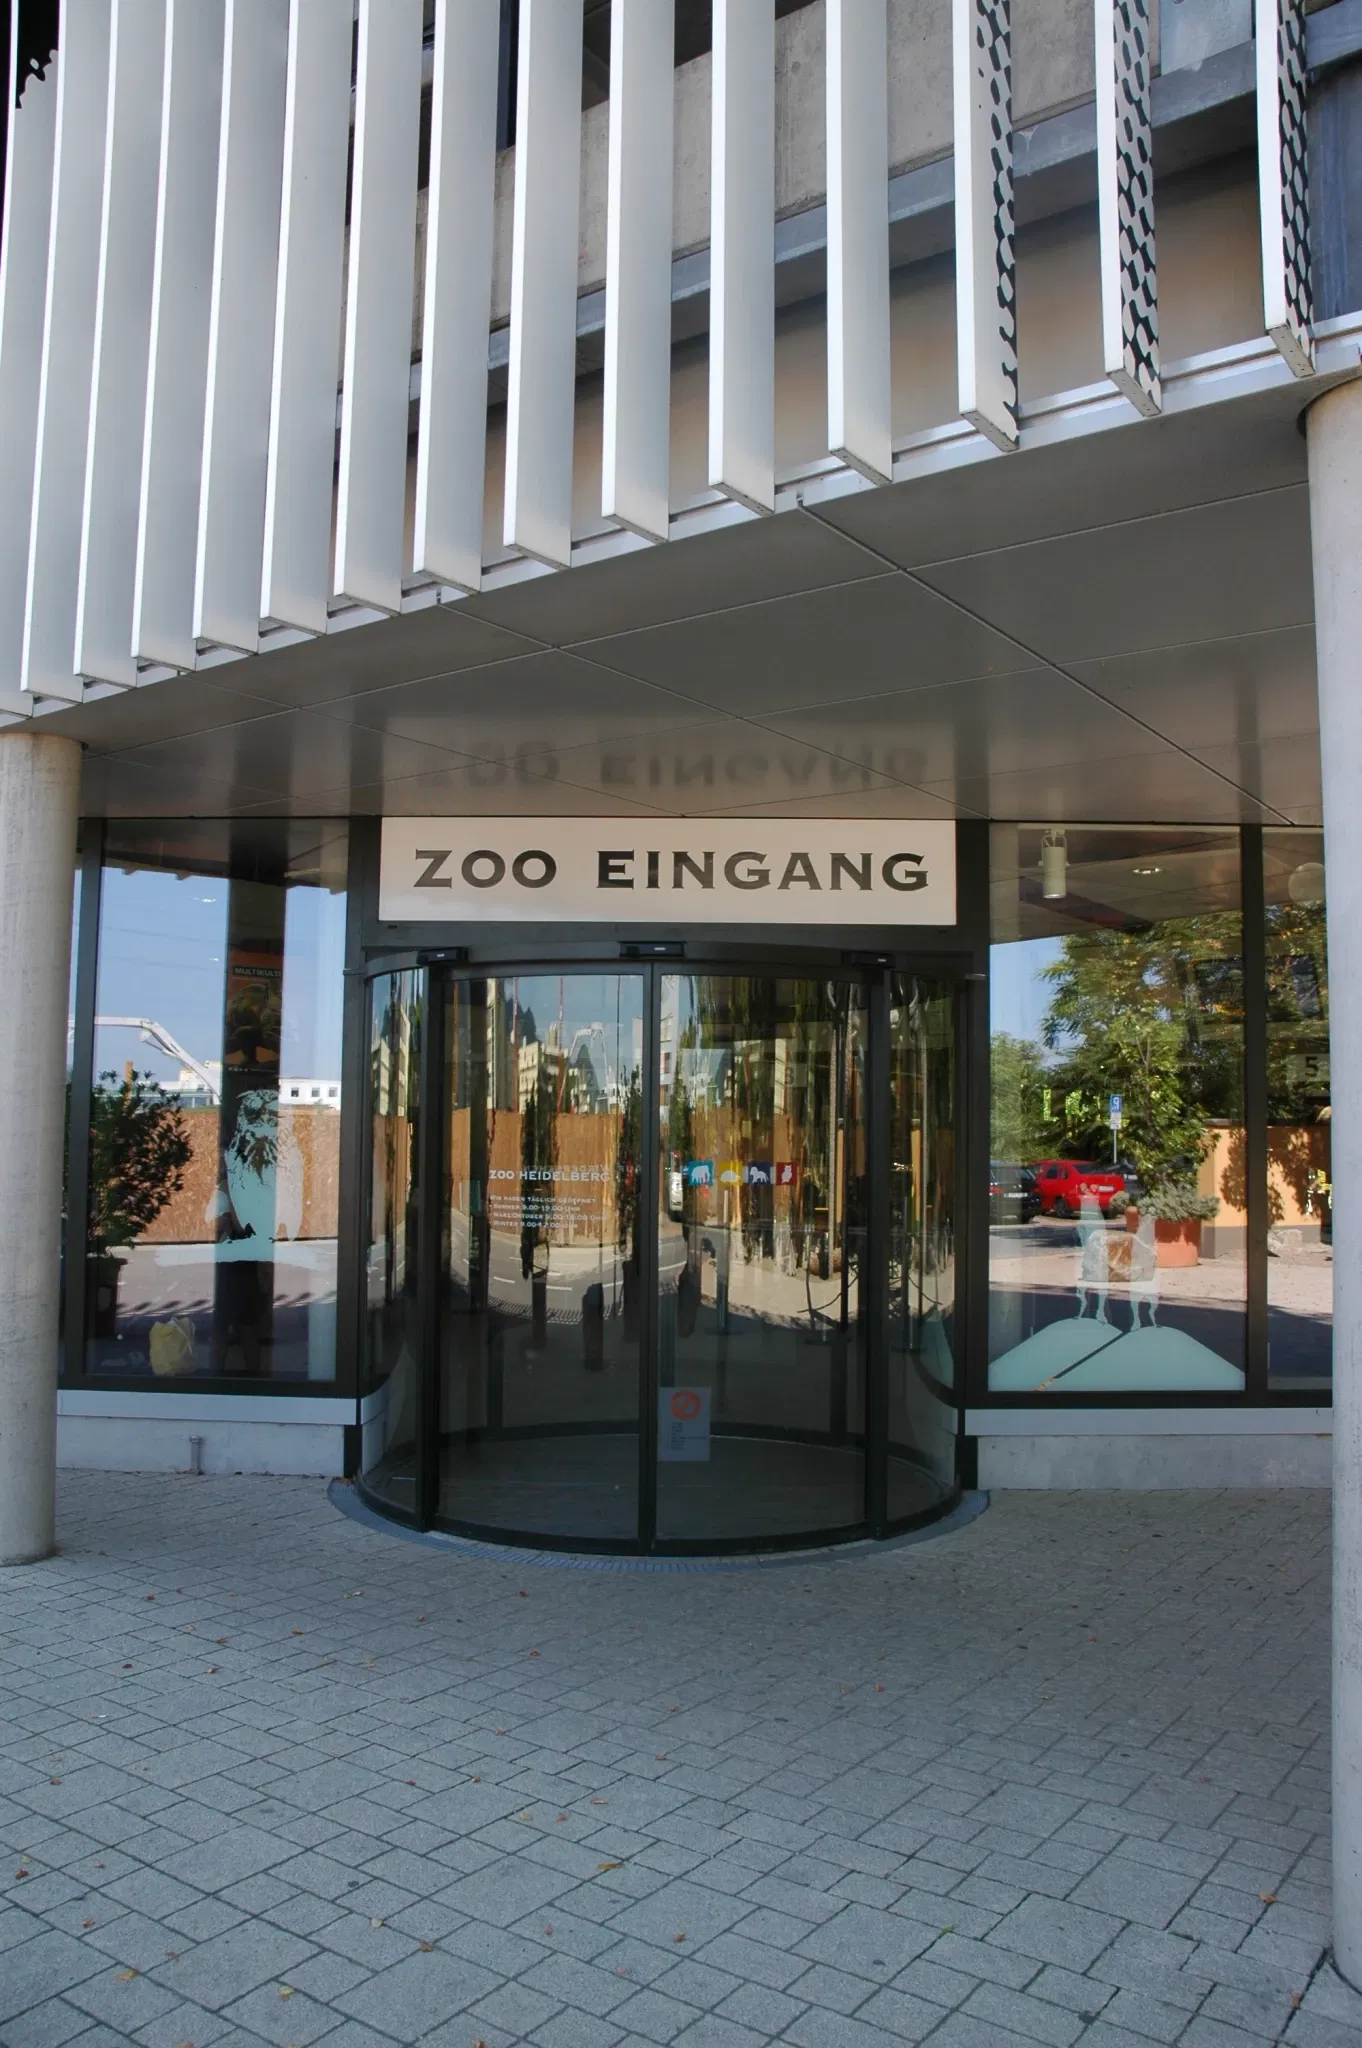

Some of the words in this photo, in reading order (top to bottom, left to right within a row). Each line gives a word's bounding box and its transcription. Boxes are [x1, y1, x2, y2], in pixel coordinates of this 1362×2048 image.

[413, 848, 557, 889] ZOO
[596, 849, 929, 892] EINGANG
[1304, 1056, 1319, 1078] 5
[488, 1169, 515, 1180] ZOO
[519, 1170, 610, 1182] HEIDELBERG
